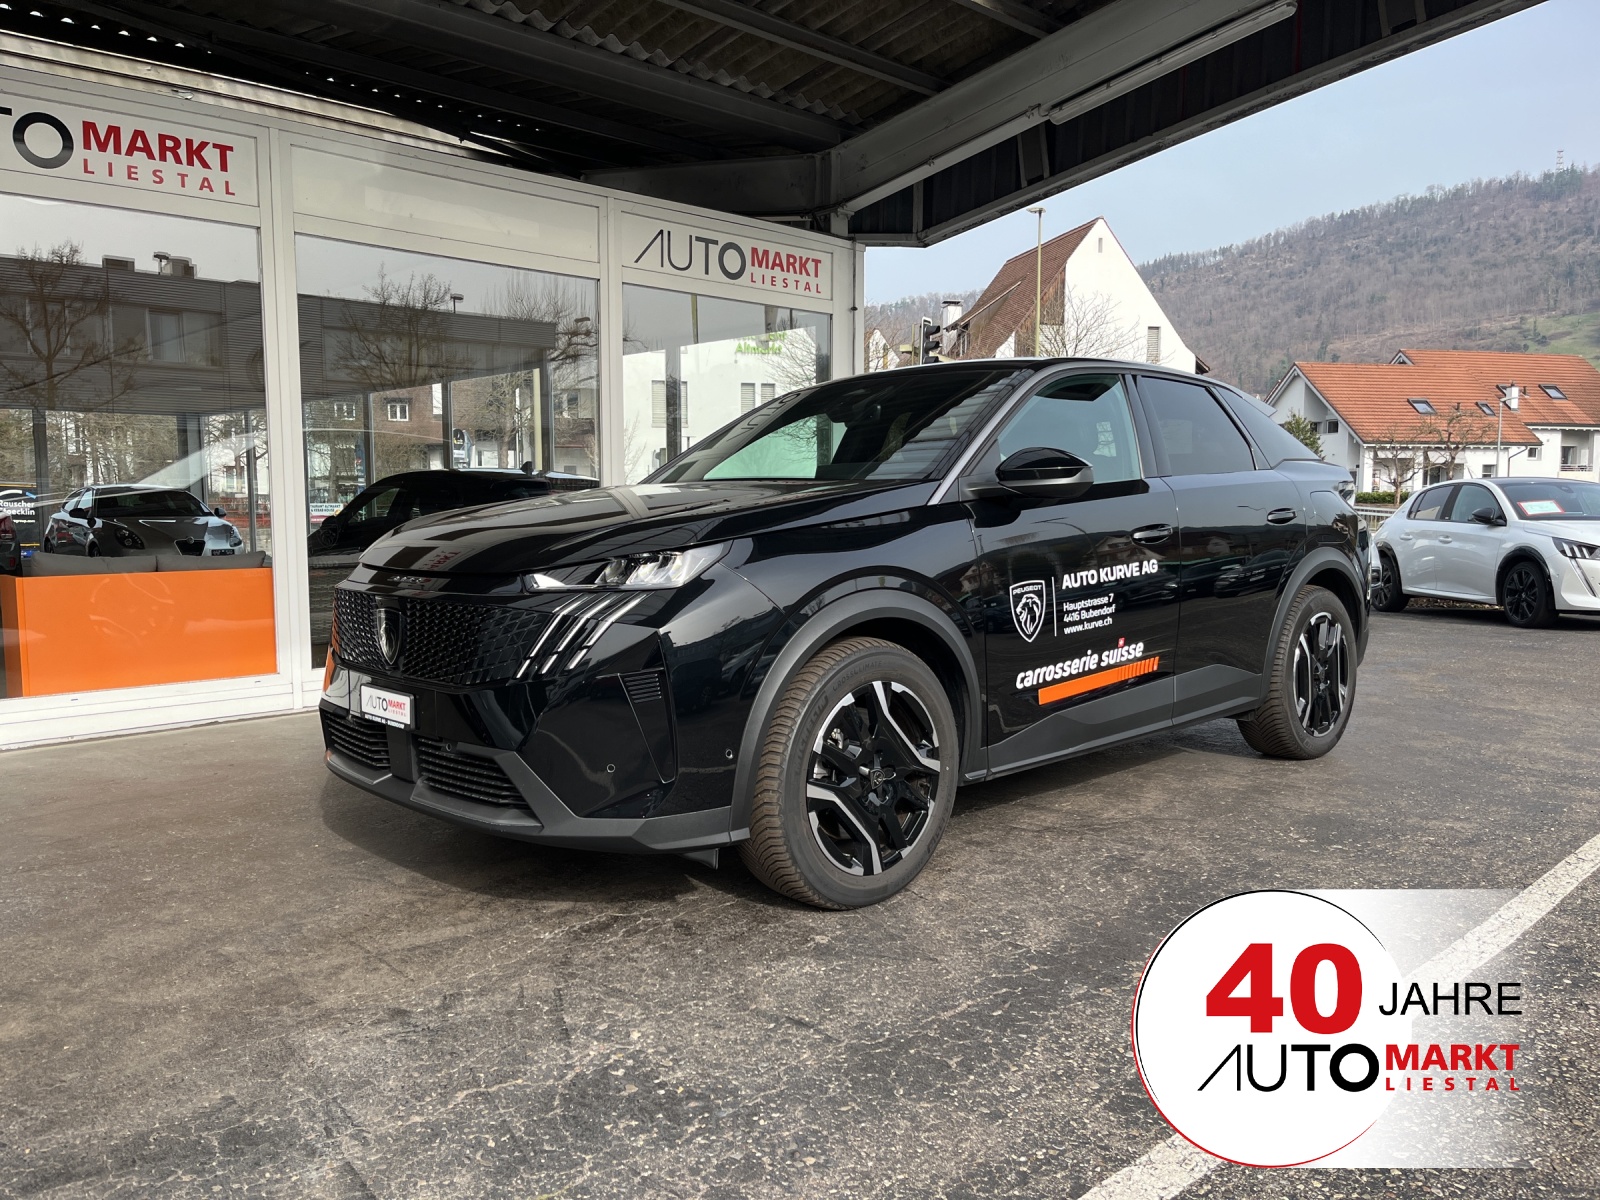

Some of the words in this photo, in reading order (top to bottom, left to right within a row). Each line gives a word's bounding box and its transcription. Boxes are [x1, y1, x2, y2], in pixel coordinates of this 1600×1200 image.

[82, 120, 234, 173] MARKT
[83, 158, 236, 196] LIESTAL
[634, 229, 747, 281] AUTO
[751, 247, 821, 278] MARKT
[751, 272, 821, 293] LIESTAL
[1062, 569, 1098, 590] AUTO
[1099, 561, 1140, 583] KURVE
[1141, 559, 1159, 575] AG
[1012, 584, 1043, 596] PEUGEOT
[1063, 595, 1109, 612] Hauptstrasse
[1108, 593, 1115, 603] 7
[1063, 612, 1080, 622] 4416
[1080, 604, 1116, 620] Bubendorf
[1063, 616, 1113, 635] www.kurve.ch
[1015, 649, 1099, 689] carrosserie
[1100, 637, 1144, 667] suisse
[366, 695, 388, 711] AUTO
[388, 699, 406, 710] MARKT
